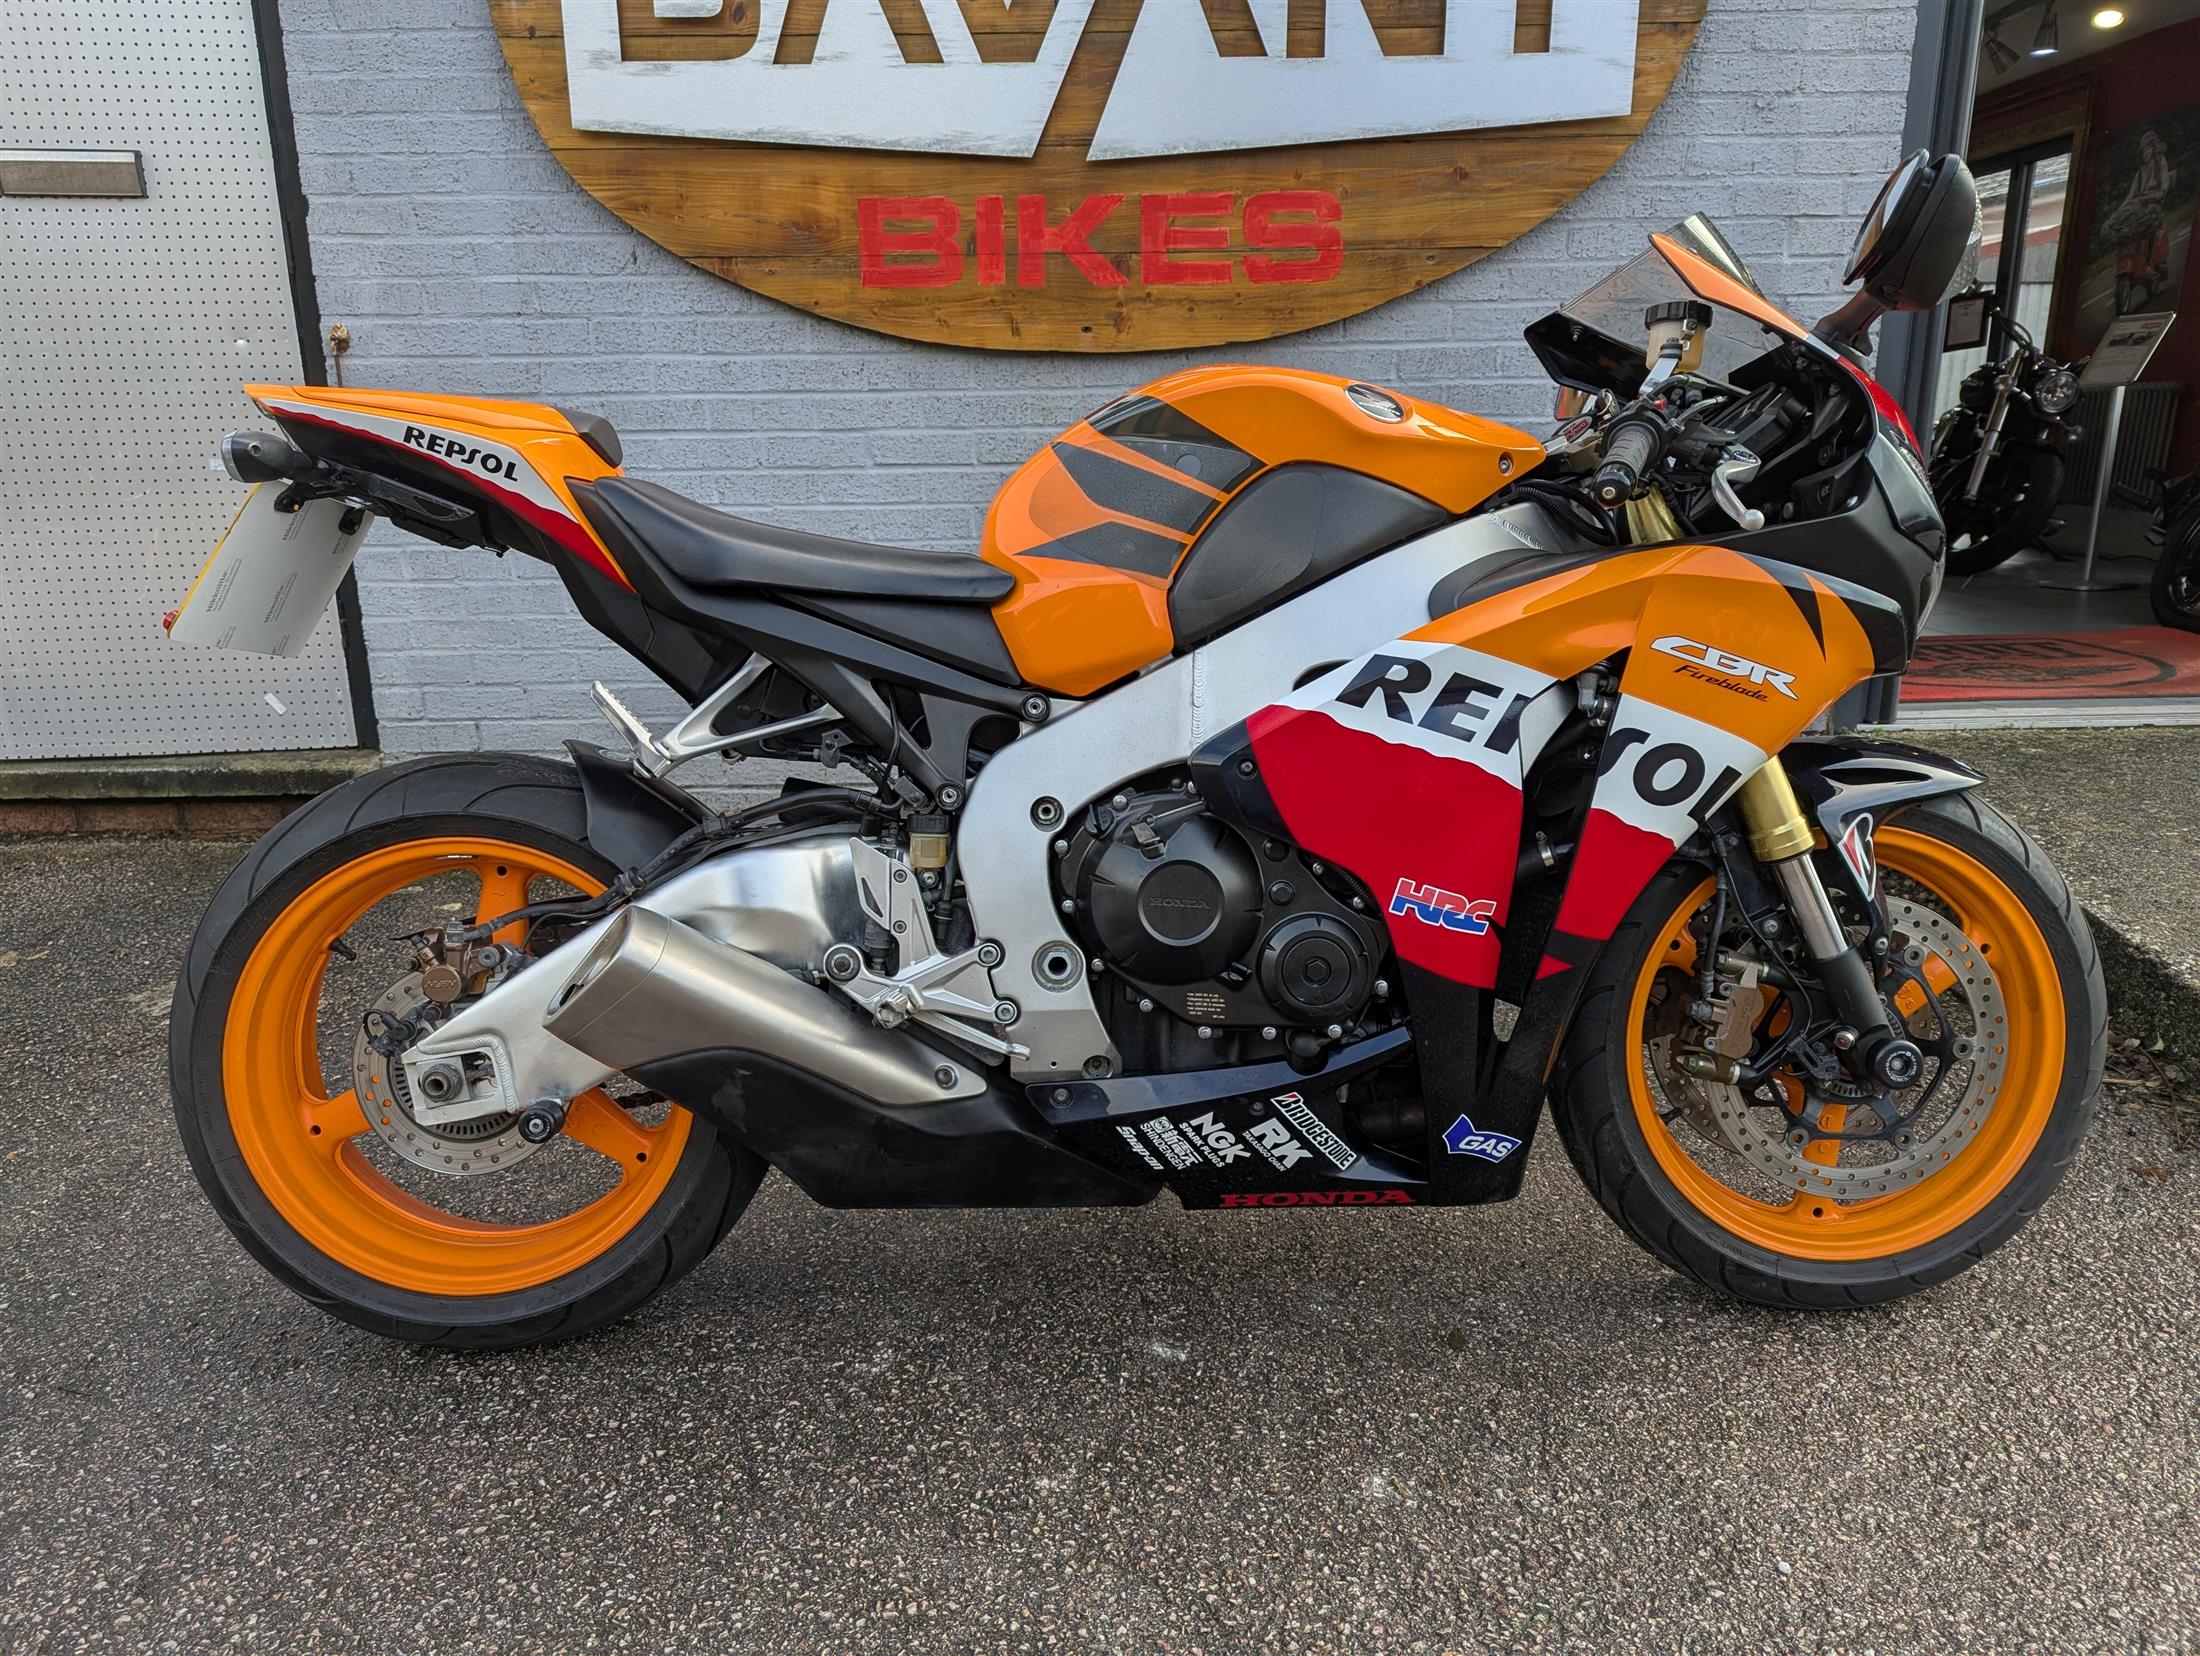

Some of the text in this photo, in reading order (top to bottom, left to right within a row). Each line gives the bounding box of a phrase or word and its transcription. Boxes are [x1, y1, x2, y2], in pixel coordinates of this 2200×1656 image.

[857, 190, 1344, 288] BIKES
[403, 425, 518, 482] REPSOL
[1650, 635, 1799, 701] CBR
[1674, 664, 1769, 702] Fireblade
[1148, 896, 1211, 910] HONDA
[1389, 877, 1497, 935] HRC
[1140, 1122, 1187, 1170] SHINDENGEN
[1179, 1122, 1226, 1168] SPARK PLUGS
[1190, 1111, 1251, 1163] NGK
[1242, 1130, 1287, 1171] TAKASAGO CHAIN
[1249, 1117, 1313, 1169] RK
[1271, 1092, 1357, 1170] BRIDGESTONE
[1459, 1135, 1513, 1157] GAS
[1219, 1190, 1416, 1207] HONDA
